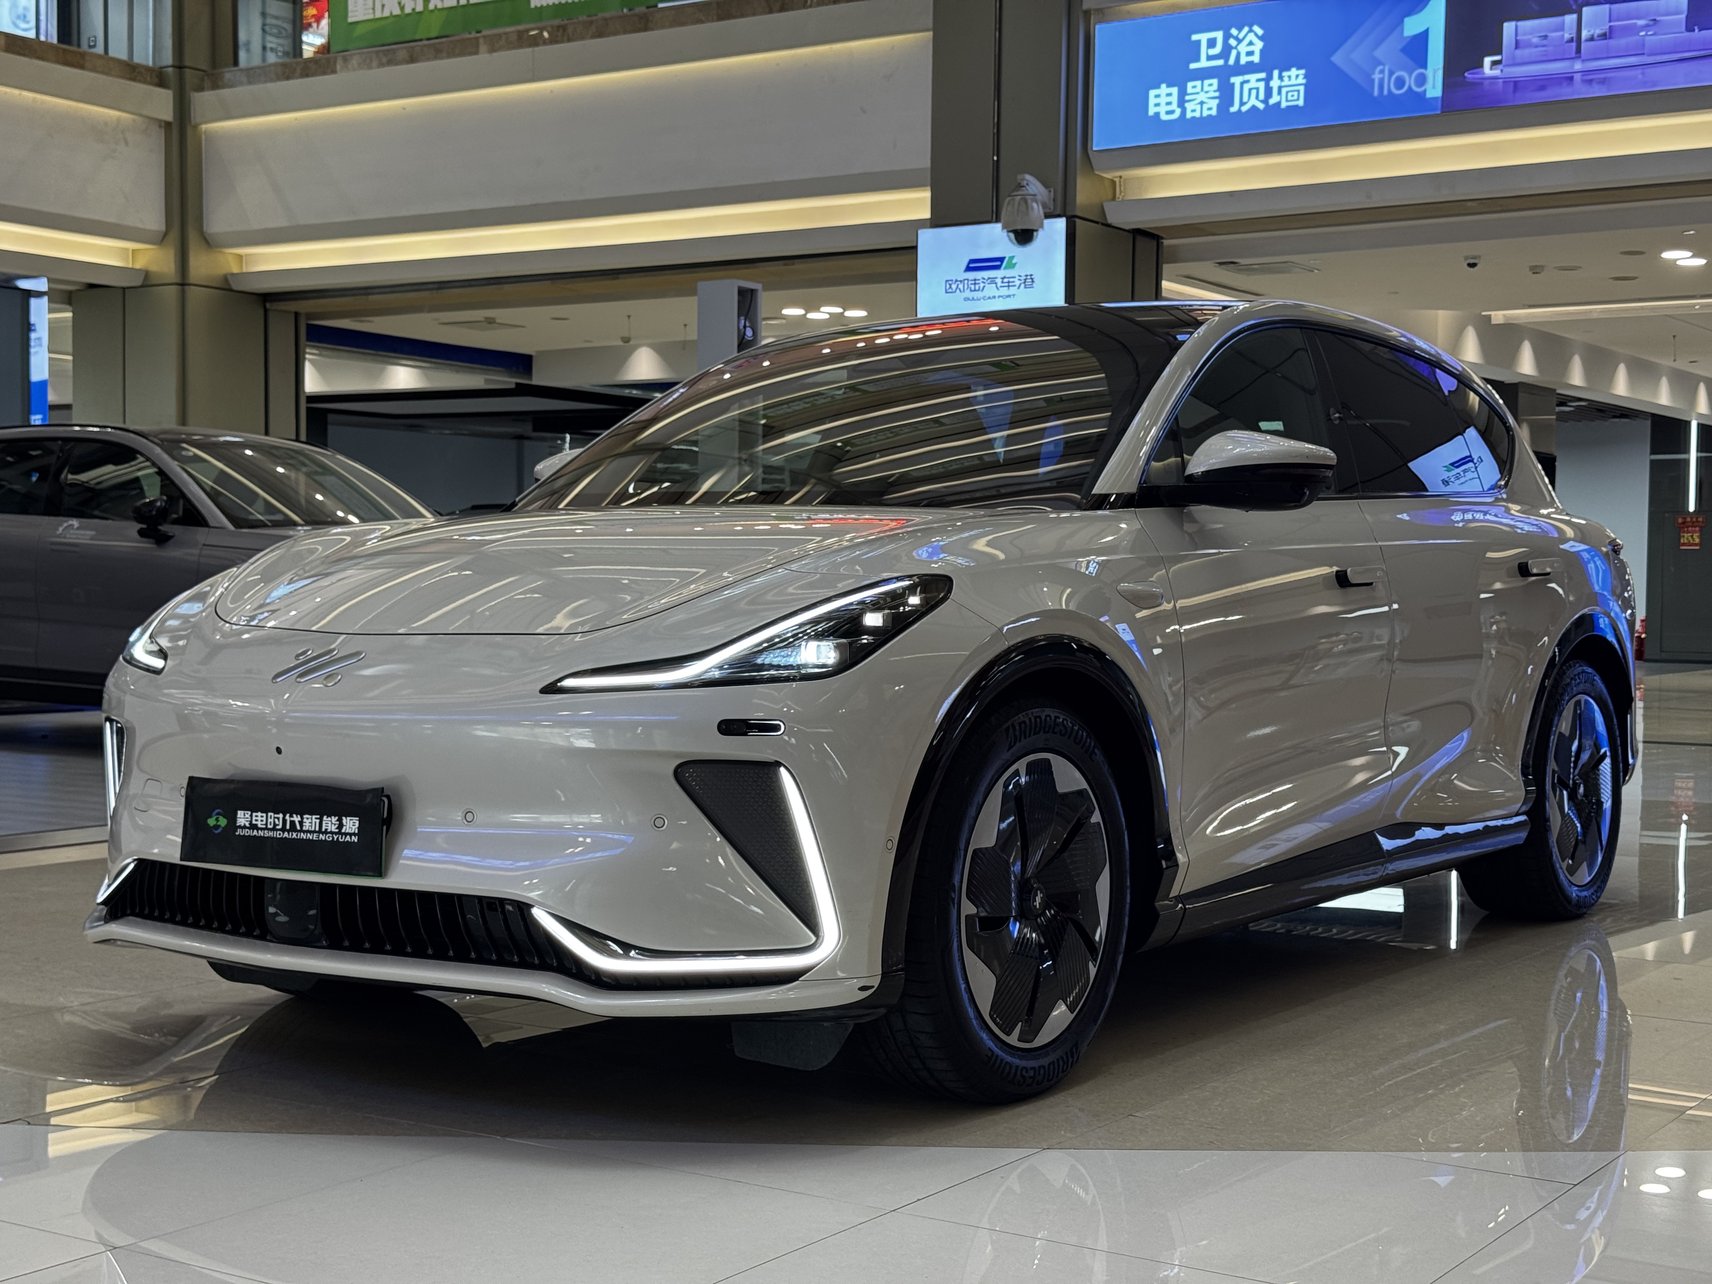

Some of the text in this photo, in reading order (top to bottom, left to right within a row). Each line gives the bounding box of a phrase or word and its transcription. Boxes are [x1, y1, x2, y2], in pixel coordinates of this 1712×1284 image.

[1189, 24, 1264, 70] 卫浴
[1403, 0, 1446, 98] 1
[1147, 68, 1307, 121] 电器 顶墙
[1371, 65, 1443, 96] floor
[944, 274, 1035, 294] 欧陆汽车港
[1004, 714, 1099, 762] BRIDGESTONE
[235, 828, 358, 842] JUDIANSHIDAIXINNENGYUAN
[236, 810, 359, 833] 聚电时代新能源
[983, 1040, 1081, 1087] BRIDGESTONE
